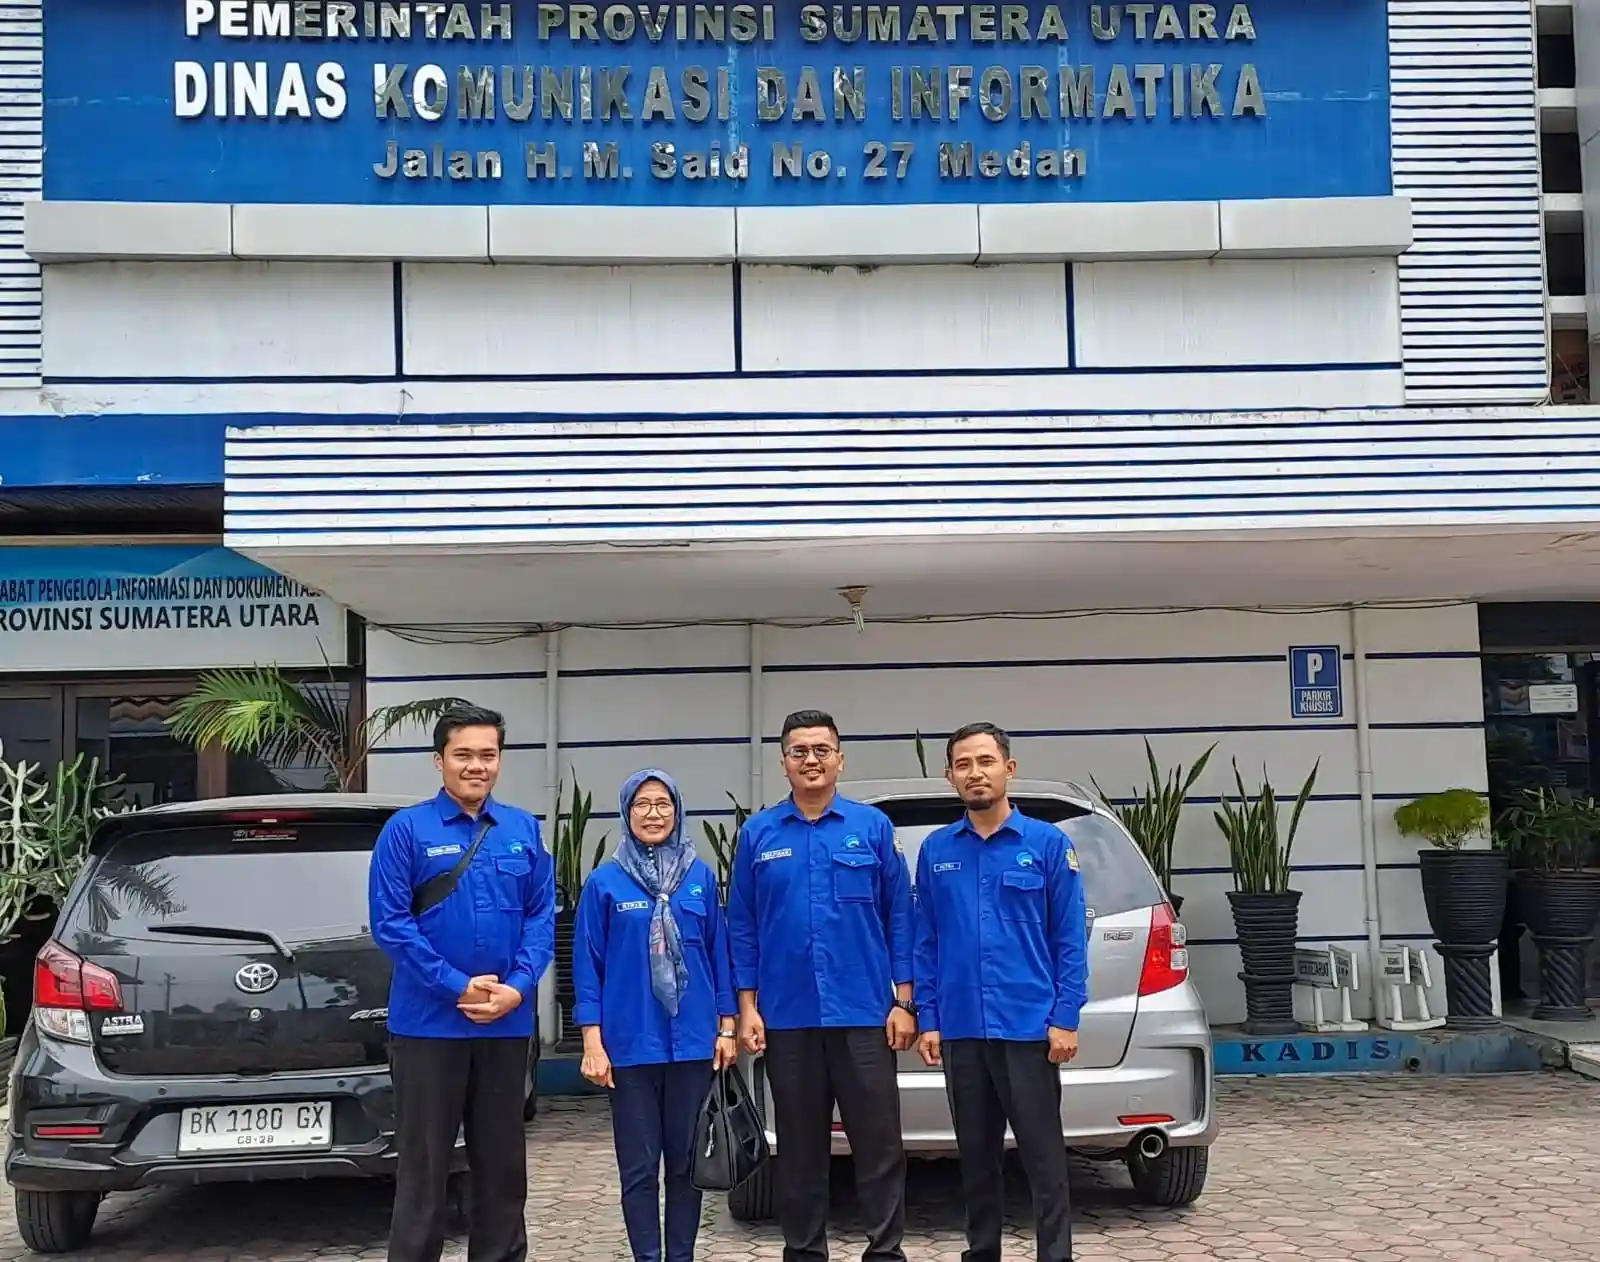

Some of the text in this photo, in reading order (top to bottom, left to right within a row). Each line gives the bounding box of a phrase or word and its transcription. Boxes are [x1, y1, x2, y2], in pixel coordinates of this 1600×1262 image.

[185, 0, 1256, 43] PEMERINTAH PROVINSI SUMATERA UTARA
[174, 61, 1267, 122] DINAS KOMUNIKASI DAN INFORMATIKA
[372, 140, 503, 180] Jalan
[650, 140, 750, 180] Said
[771, 143, 848, 179] No.
[863, 141, 915, 179] 27
[938, 140, 1088, 179] Medan
[38, 577, 113, 601] PENGELOLA
[116, 576, 189, 600] INFORMASI
[194, 576, 223, 600] DAN
[99, 603, 232, 631] SUMATERA
[239, 602, 321, 628] UTARA
[1307, 652, 1323, 685] P
[103, 1014, 143, 1027] ASTRA
[1241, 1039, 1391, 1063] KADIS
[190, 1106, 324, 1135] BK 1180 GX
